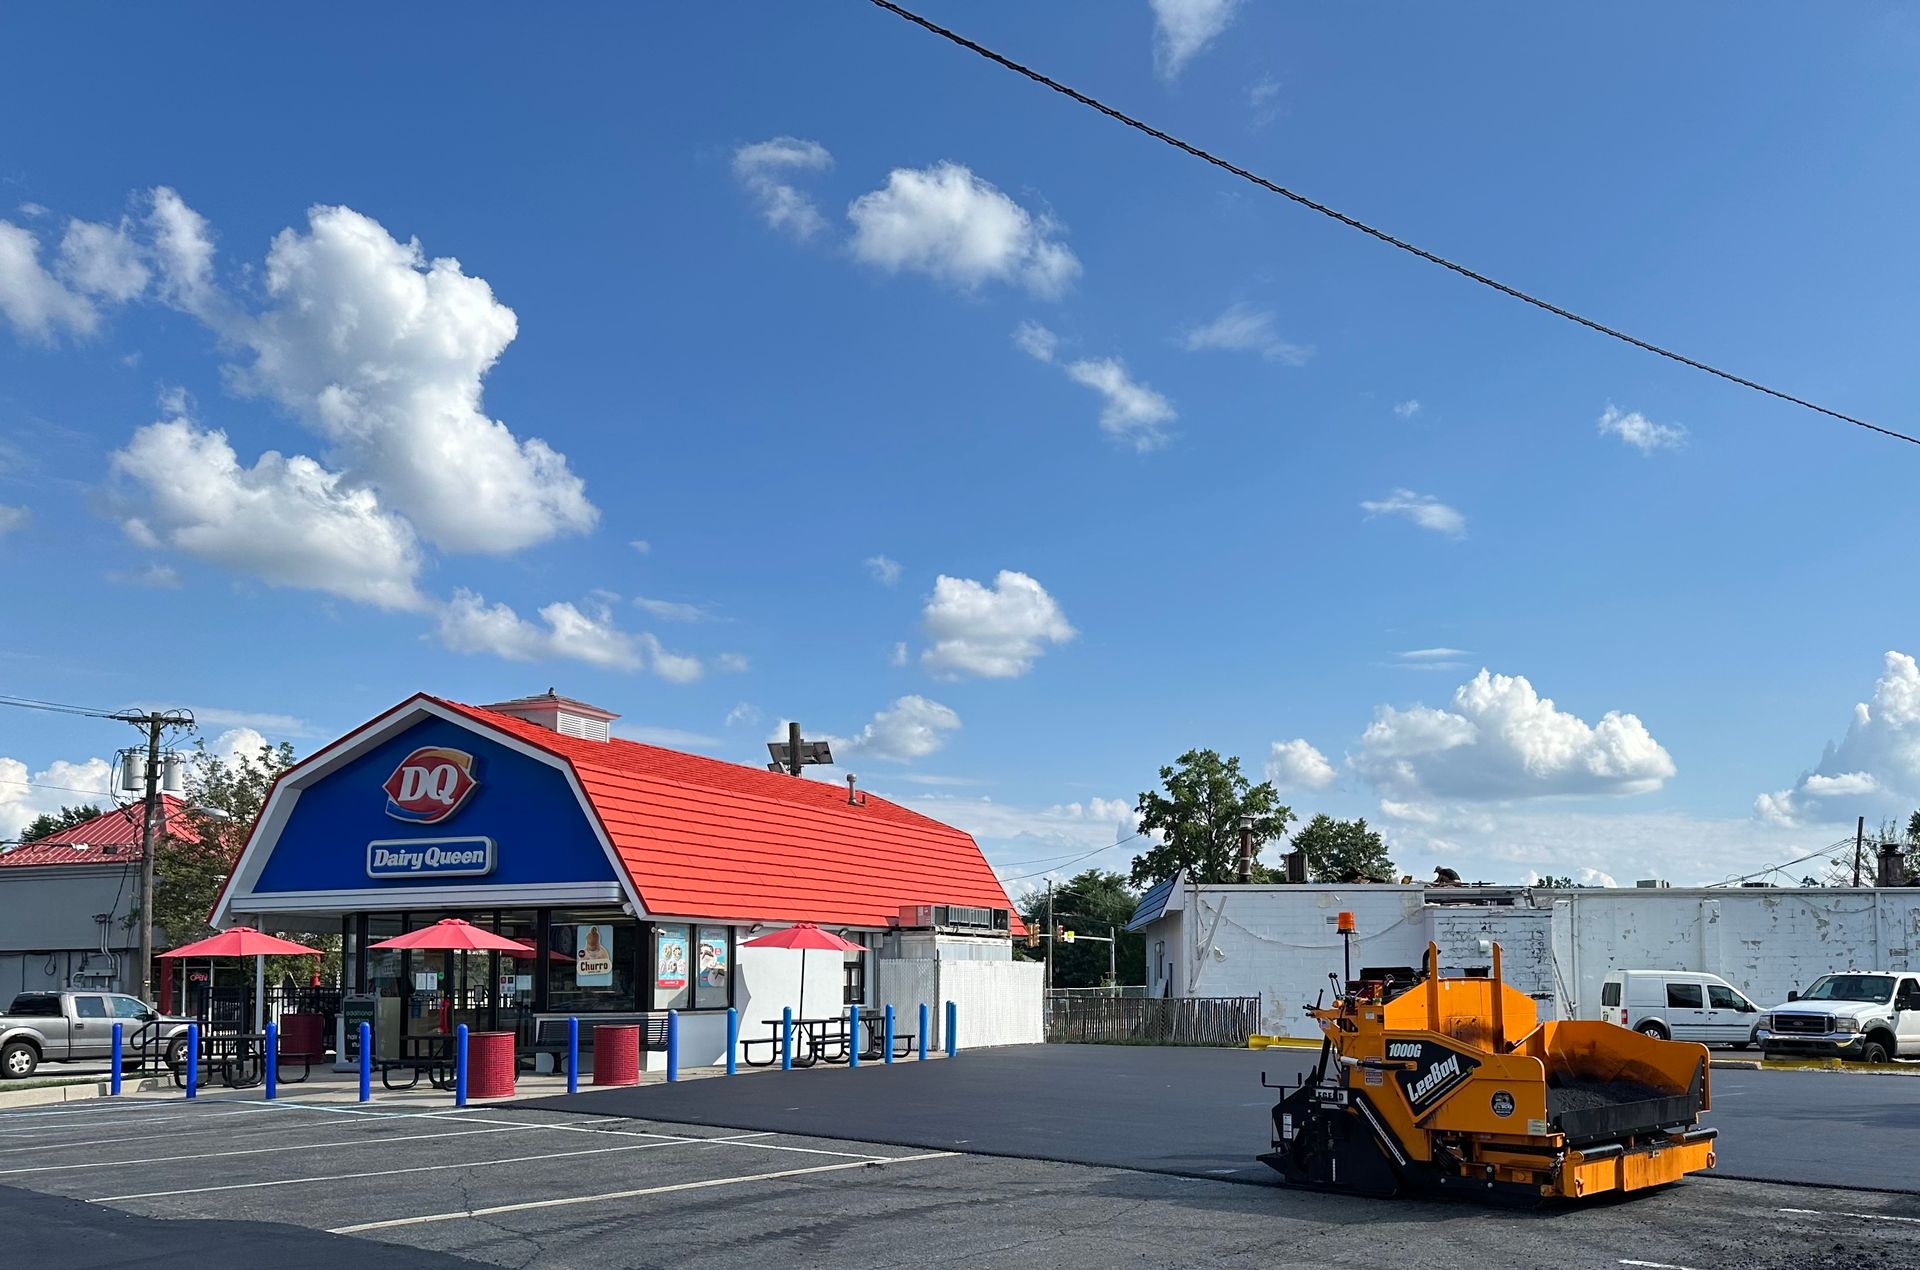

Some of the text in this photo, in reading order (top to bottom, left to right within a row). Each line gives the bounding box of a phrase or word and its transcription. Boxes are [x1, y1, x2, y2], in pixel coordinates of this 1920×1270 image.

[398, 764, 458, 805] DQ
[373, 847, 484, 870] Dairy Queen
[580, 961, 608, 971] Churro
[1389, 1043, 1422, 1058] 1000G
[1407, 1053, 1460, 1102] LeeBoy
